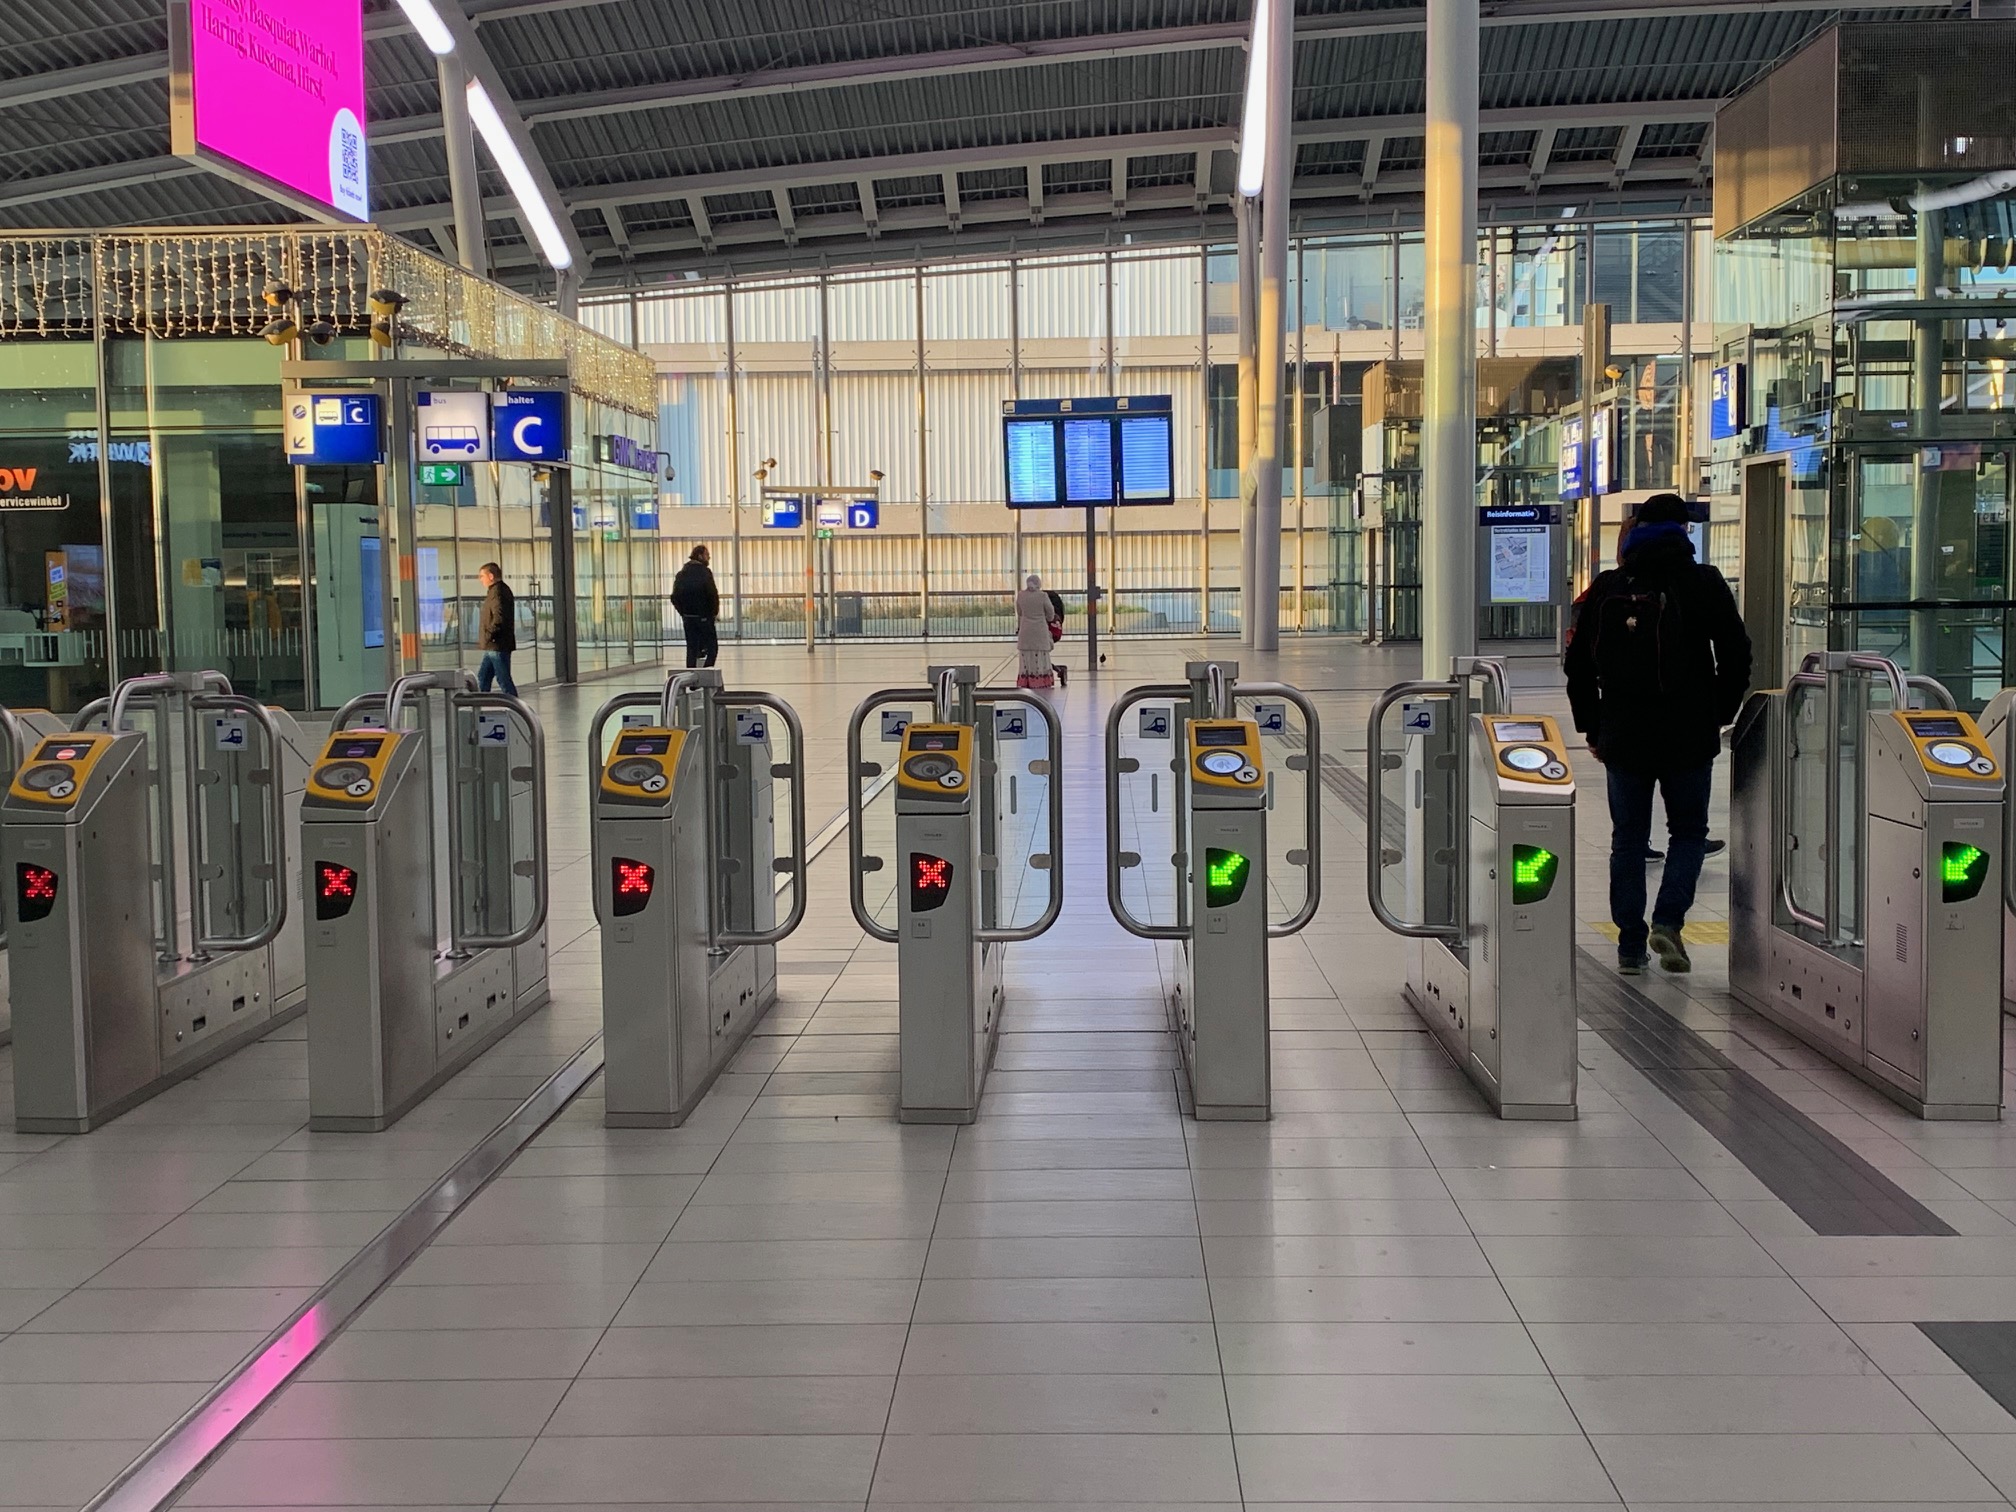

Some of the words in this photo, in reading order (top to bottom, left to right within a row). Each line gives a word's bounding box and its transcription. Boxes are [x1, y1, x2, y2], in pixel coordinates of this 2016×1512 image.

[248, 32, 297, 88] Kusama,
[508, 396, 535, 404] haltes
[351, 407, 364, 422] C
[513, 416, 543, 455] C
[0, 468, 37, 491] OV
[788, 504, 796, 512] D
[1486, 510, 1535, 518] Reisinformatie
[854, 510, 870, 527] D
